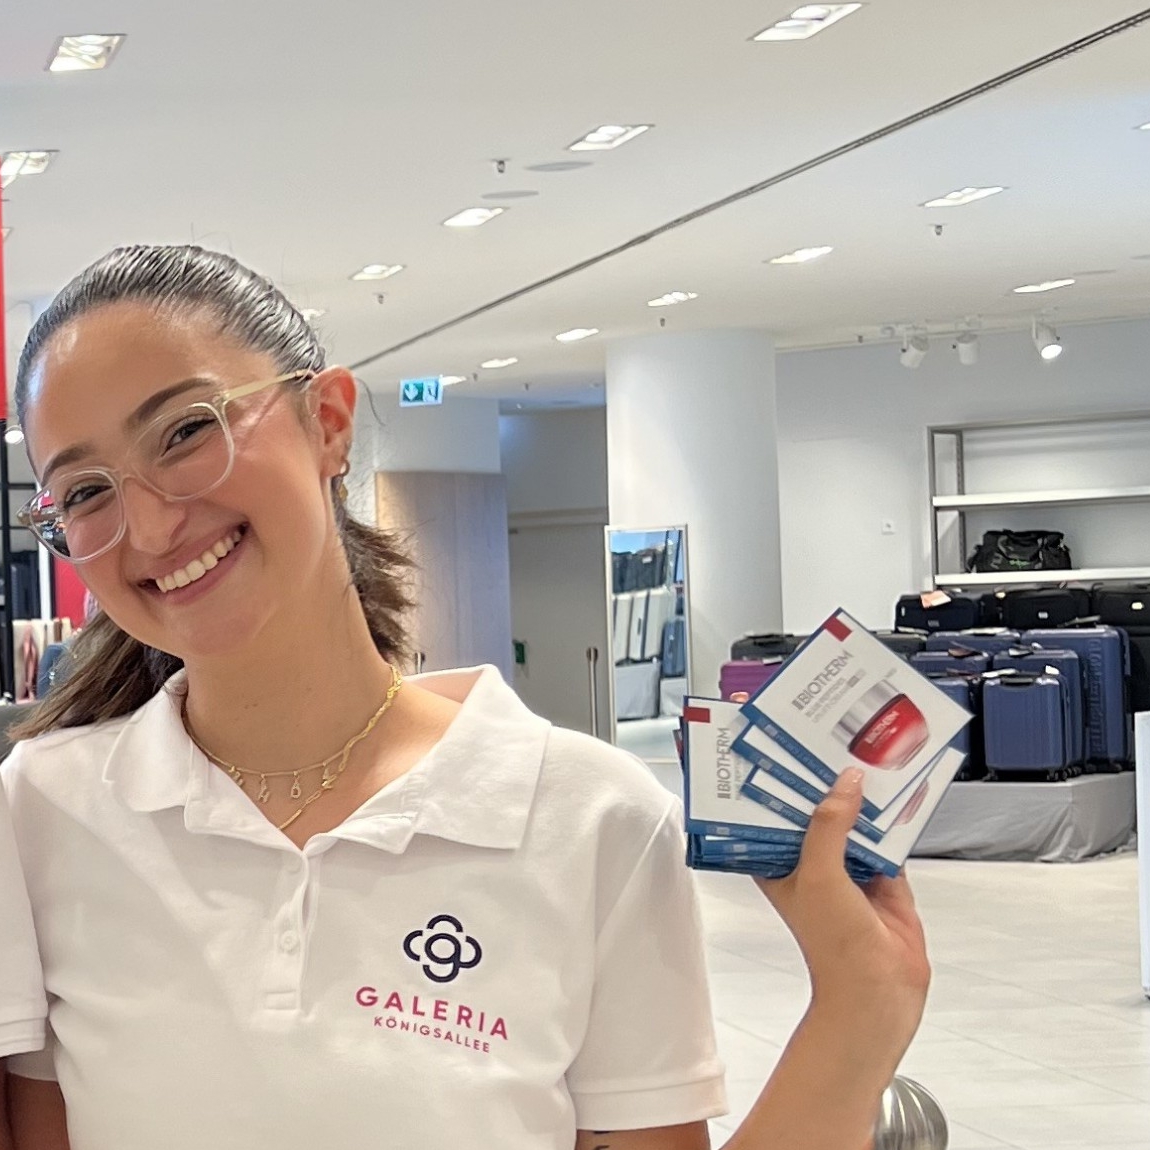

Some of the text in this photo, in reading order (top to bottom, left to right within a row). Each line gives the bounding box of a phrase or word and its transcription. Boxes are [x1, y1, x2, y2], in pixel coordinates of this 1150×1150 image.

[794, 649, 854, 708] BIOTHERM
[716, 727, 731, 793] BIOTHERM
[355, 986, 508, 1040] GALERIA
[373, 1016, 490, 1053] KÖNIGSALLEE
